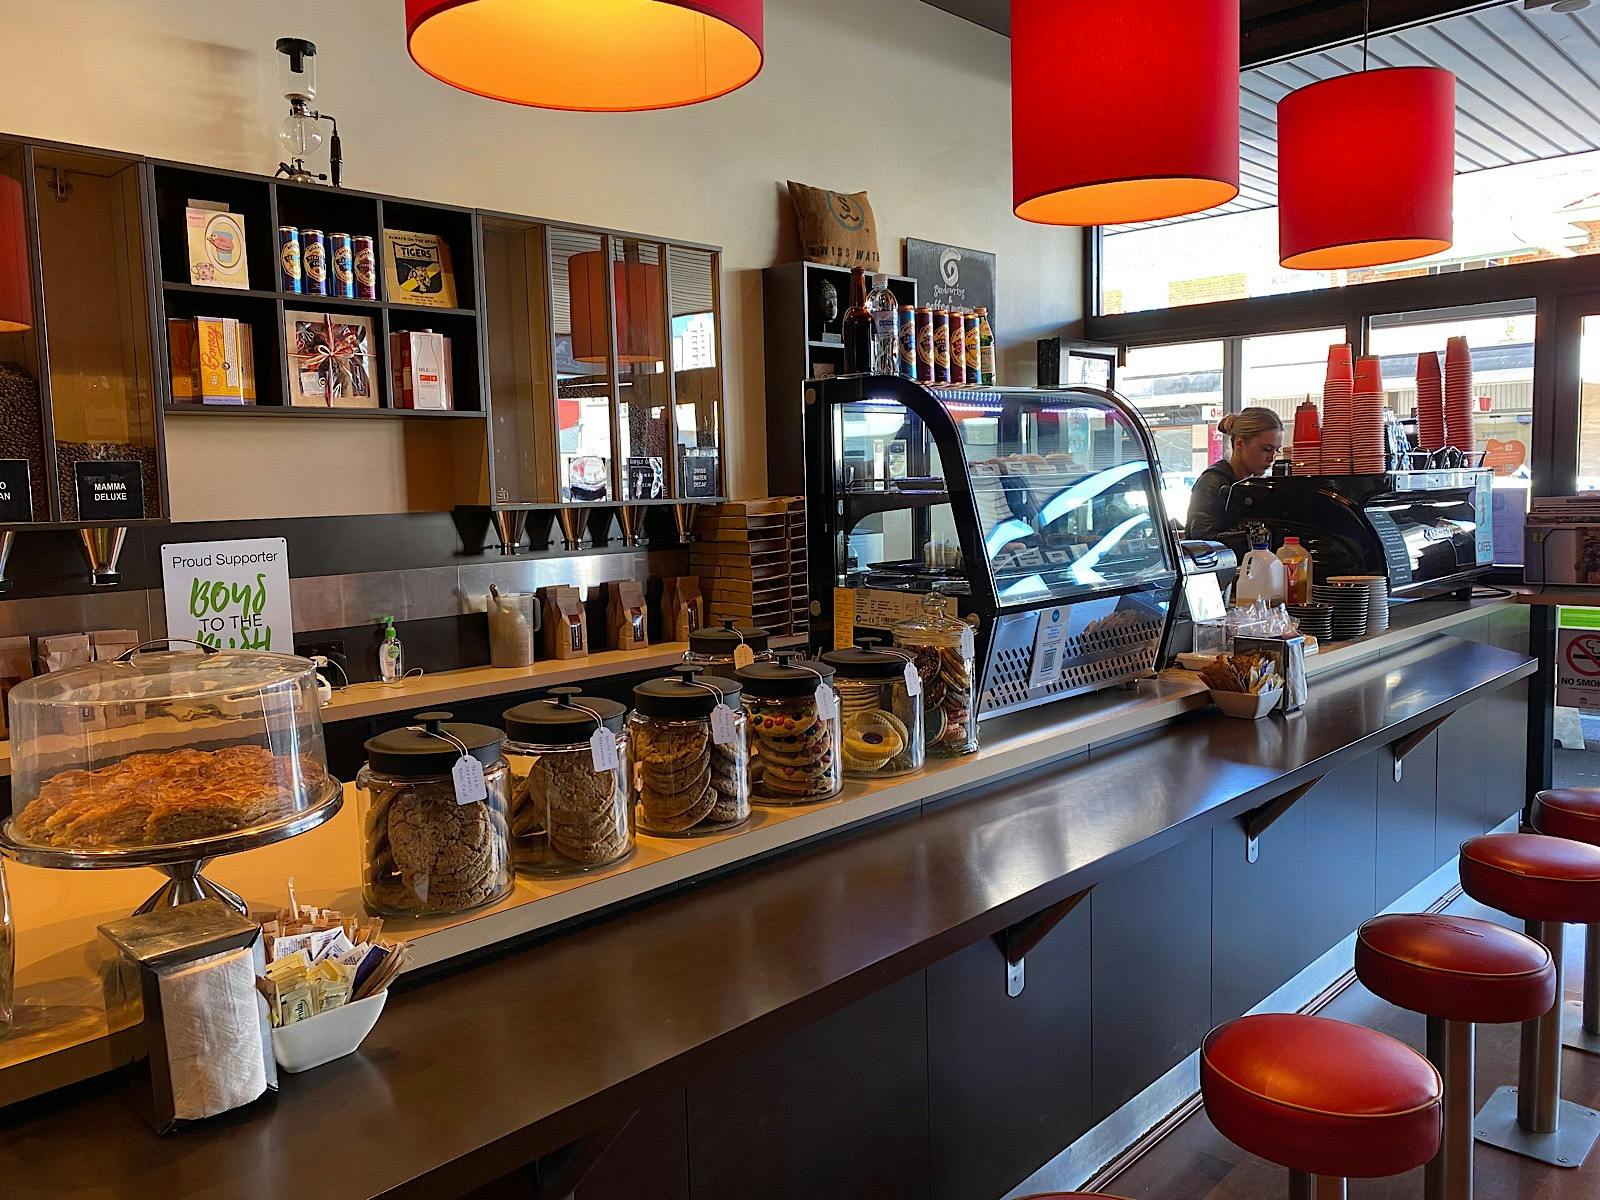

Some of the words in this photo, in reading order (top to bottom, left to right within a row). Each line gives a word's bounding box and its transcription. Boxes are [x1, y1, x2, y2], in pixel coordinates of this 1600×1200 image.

[401, 247, 432, 258] TIGERS
[808, 246, 850, 258] SWISS
[94, 482, 127, 491] MAMMA
[94, 492, 128, 501] DELUXE
[172, 555, 212, 568] Proud
[216, 551, 278, 567] Supporter
[199, 617, 225, 632] TO
[229, 613, 263, 629] THE
[1561, 677, 1575, 686] NO
